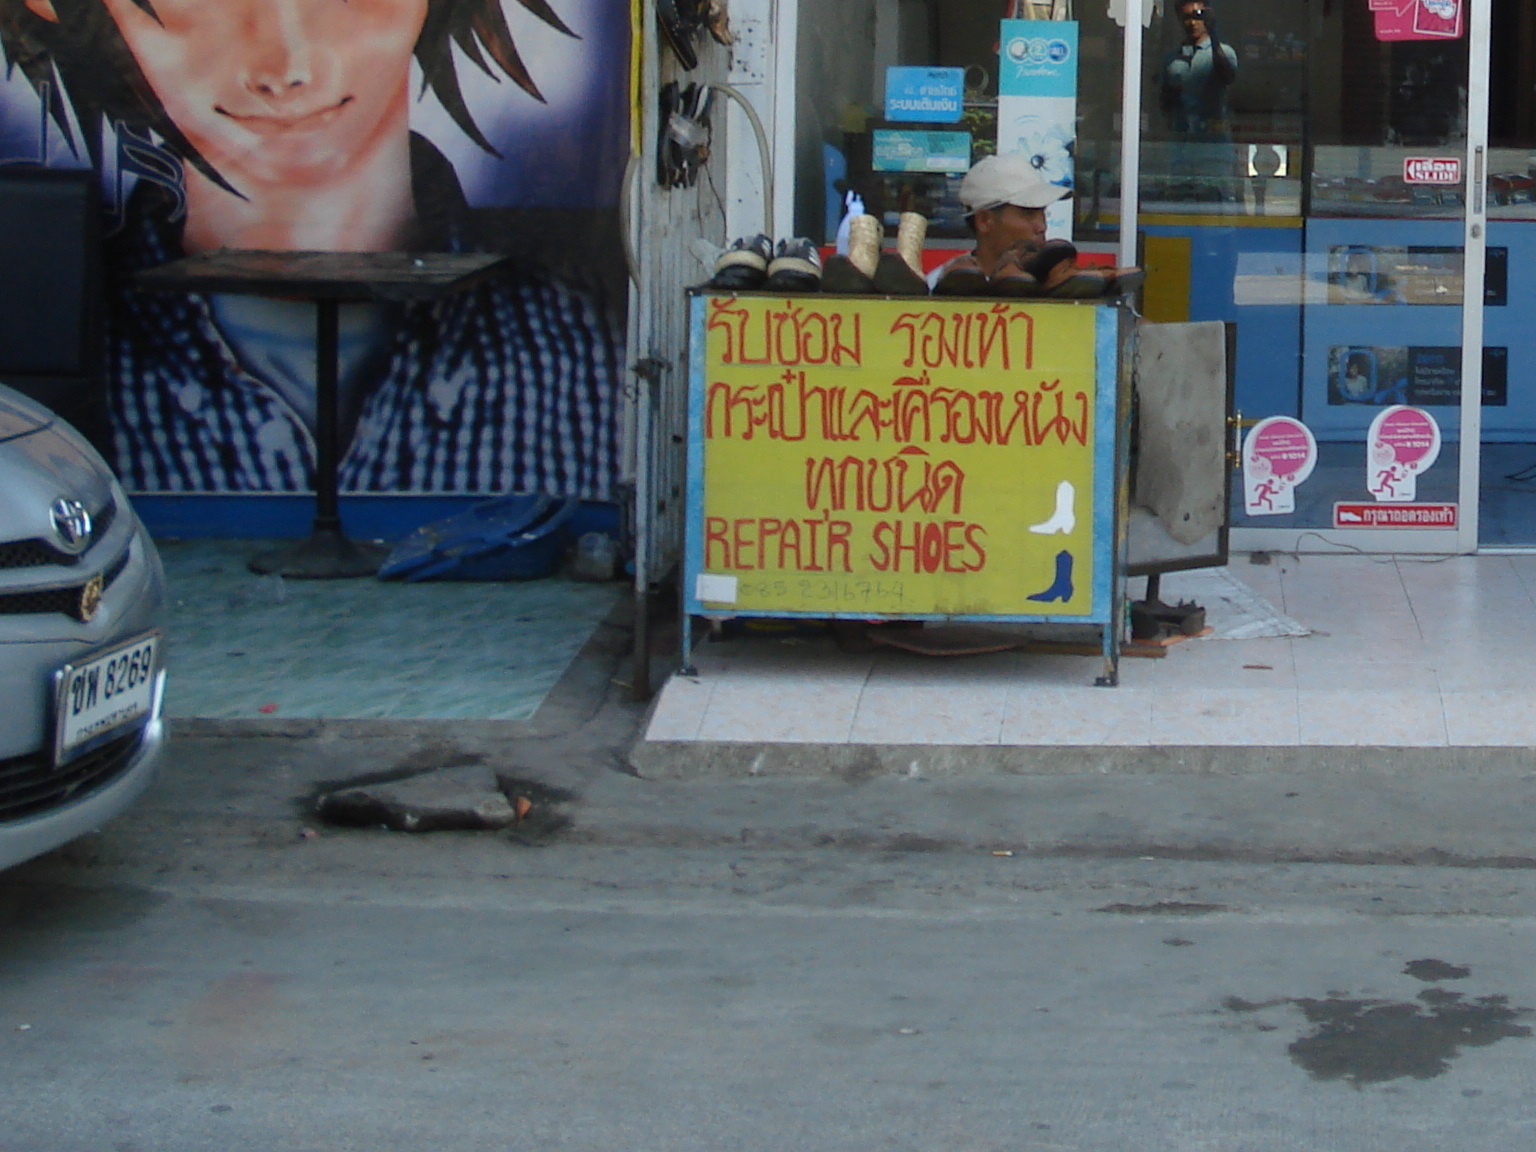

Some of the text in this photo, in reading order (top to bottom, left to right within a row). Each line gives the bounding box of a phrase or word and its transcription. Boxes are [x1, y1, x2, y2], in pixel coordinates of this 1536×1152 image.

[707, 297, 1034, 370] รับซ่อม รองเท้า
[705, 516, 987, 574] REPAIR SHOES
[104, 645, 151, 700] 8269
